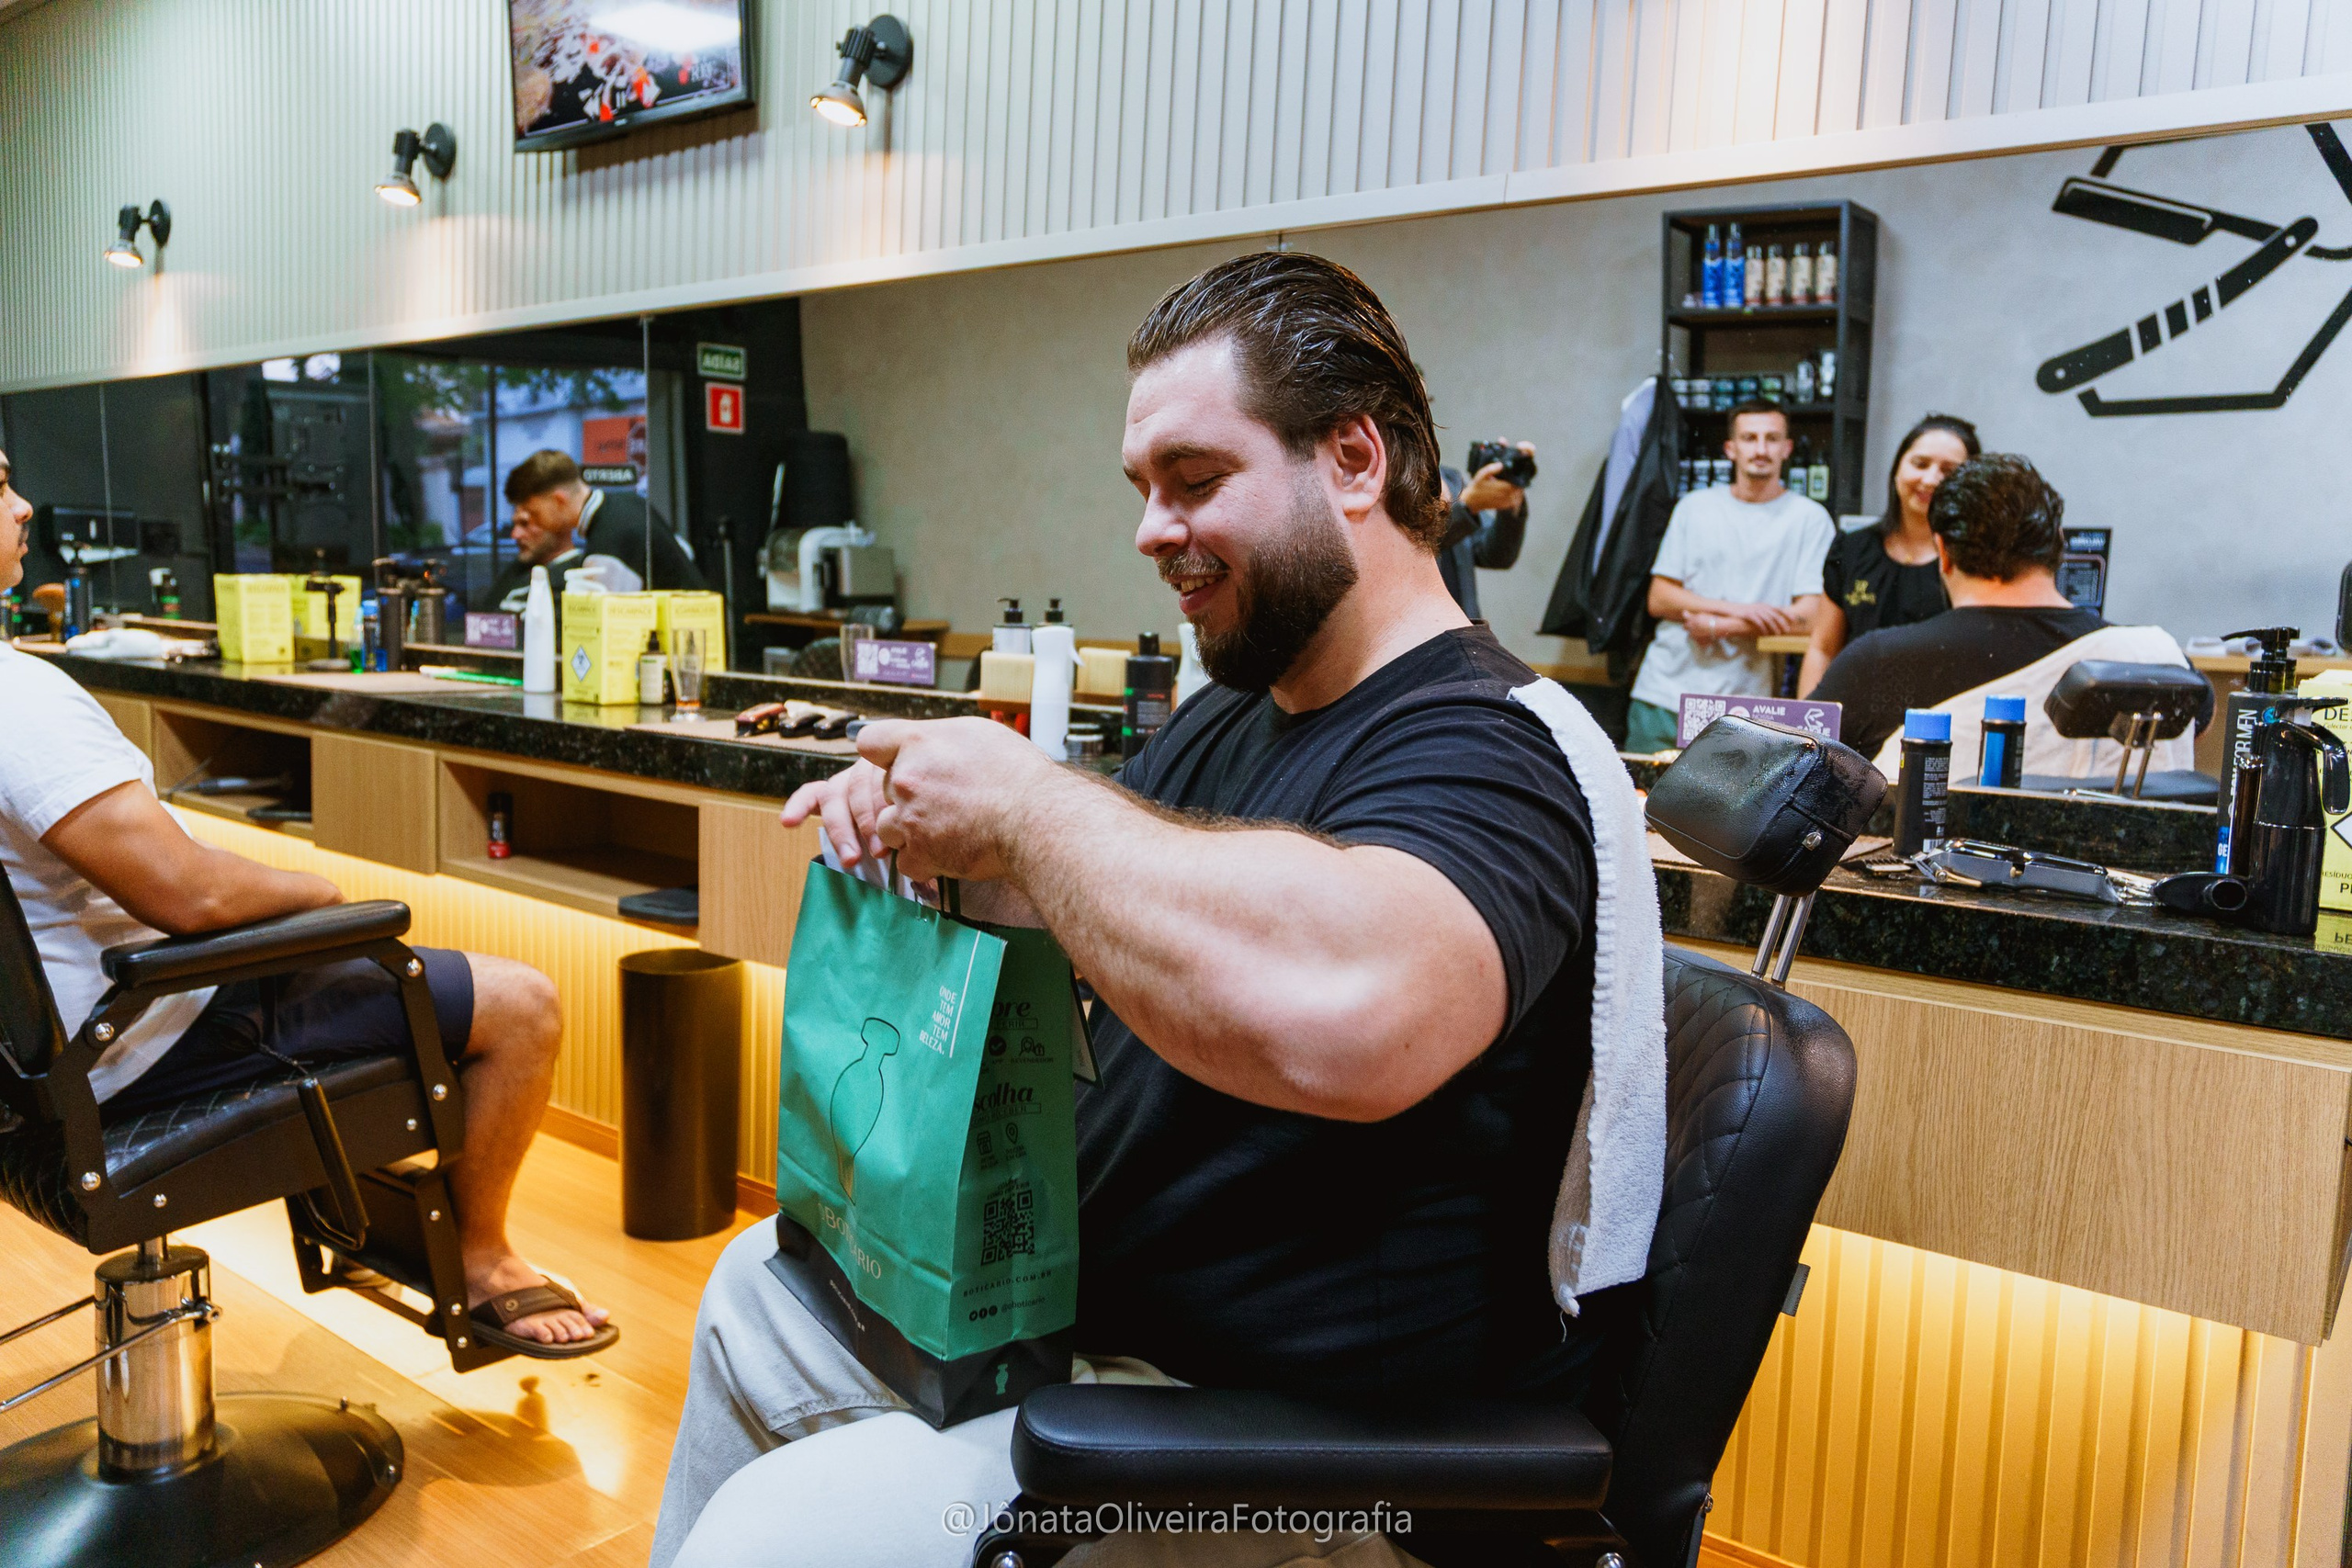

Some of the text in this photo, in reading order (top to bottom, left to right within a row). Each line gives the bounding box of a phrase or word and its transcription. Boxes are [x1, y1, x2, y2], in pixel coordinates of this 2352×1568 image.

[1753, 705, 1786, 716] AVALIE
[2324, 708, 2352, 722] DE
[2339, 882, 2352, 894] P
[939, 985, 957, 1004] ONDE
[940, 999, 955, 1017] TEM
[932, 1010, 951, 1029] AMOR
[933, 1024, 949, 1042] TEM
[919, 1030, 945, 1055] BELEZA.
